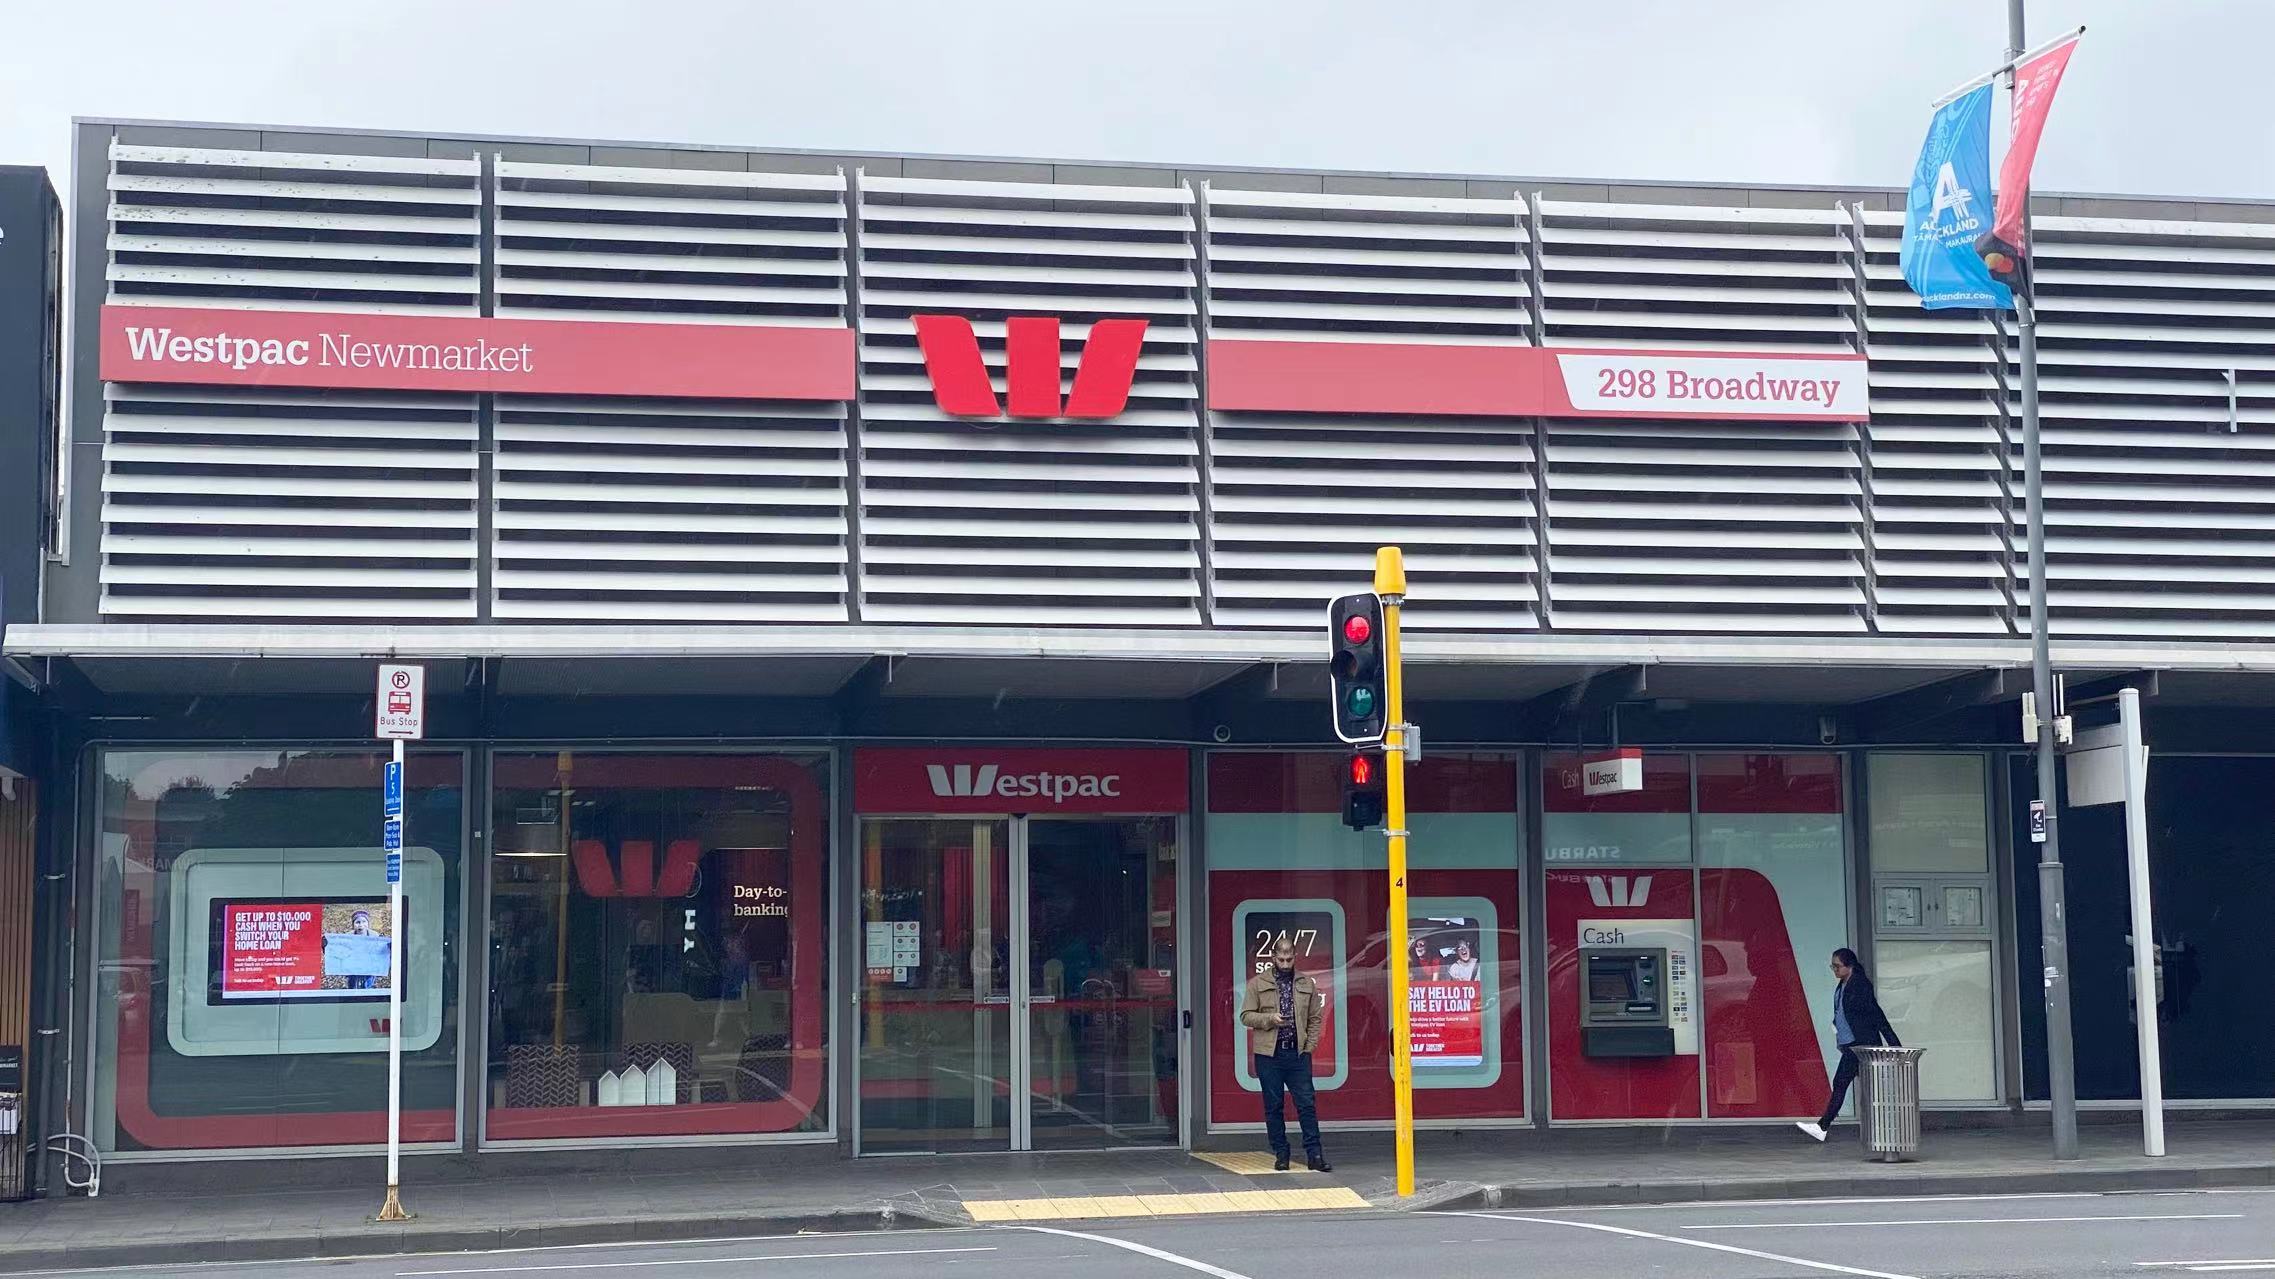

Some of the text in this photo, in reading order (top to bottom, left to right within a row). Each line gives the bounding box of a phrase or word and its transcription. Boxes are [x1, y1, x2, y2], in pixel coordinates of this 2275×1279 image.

[125, 327, 534, 373] Westpac Newmarket
[1598, 368, 1841, 408] 298 Broadway
[380, 716, 418, 727] Bus Stop
[926, 764, 1120, 803] Westpac
[1588, 771, 1617, 787] Westpac
[1395, 876, 1404, 888] 4
[733, 885, 788, 900] Day-to-
[235, 912, 252, 922] GET
[252, 912, 264, 921] UP
[265, 912, 276, 921] TO
[235, 921, 300, 931] CASH WHEN YOU
[235, 931, 289, 941] SWITCH YOUR
[1583, 927, 1624, 944] Cash
[234, 940, 282, 950] HOME LOAN
[1409, 987, 1476, 999] SAY HELLO TO
[1410, 1000, 1471, 1012] THE EV LOAN
